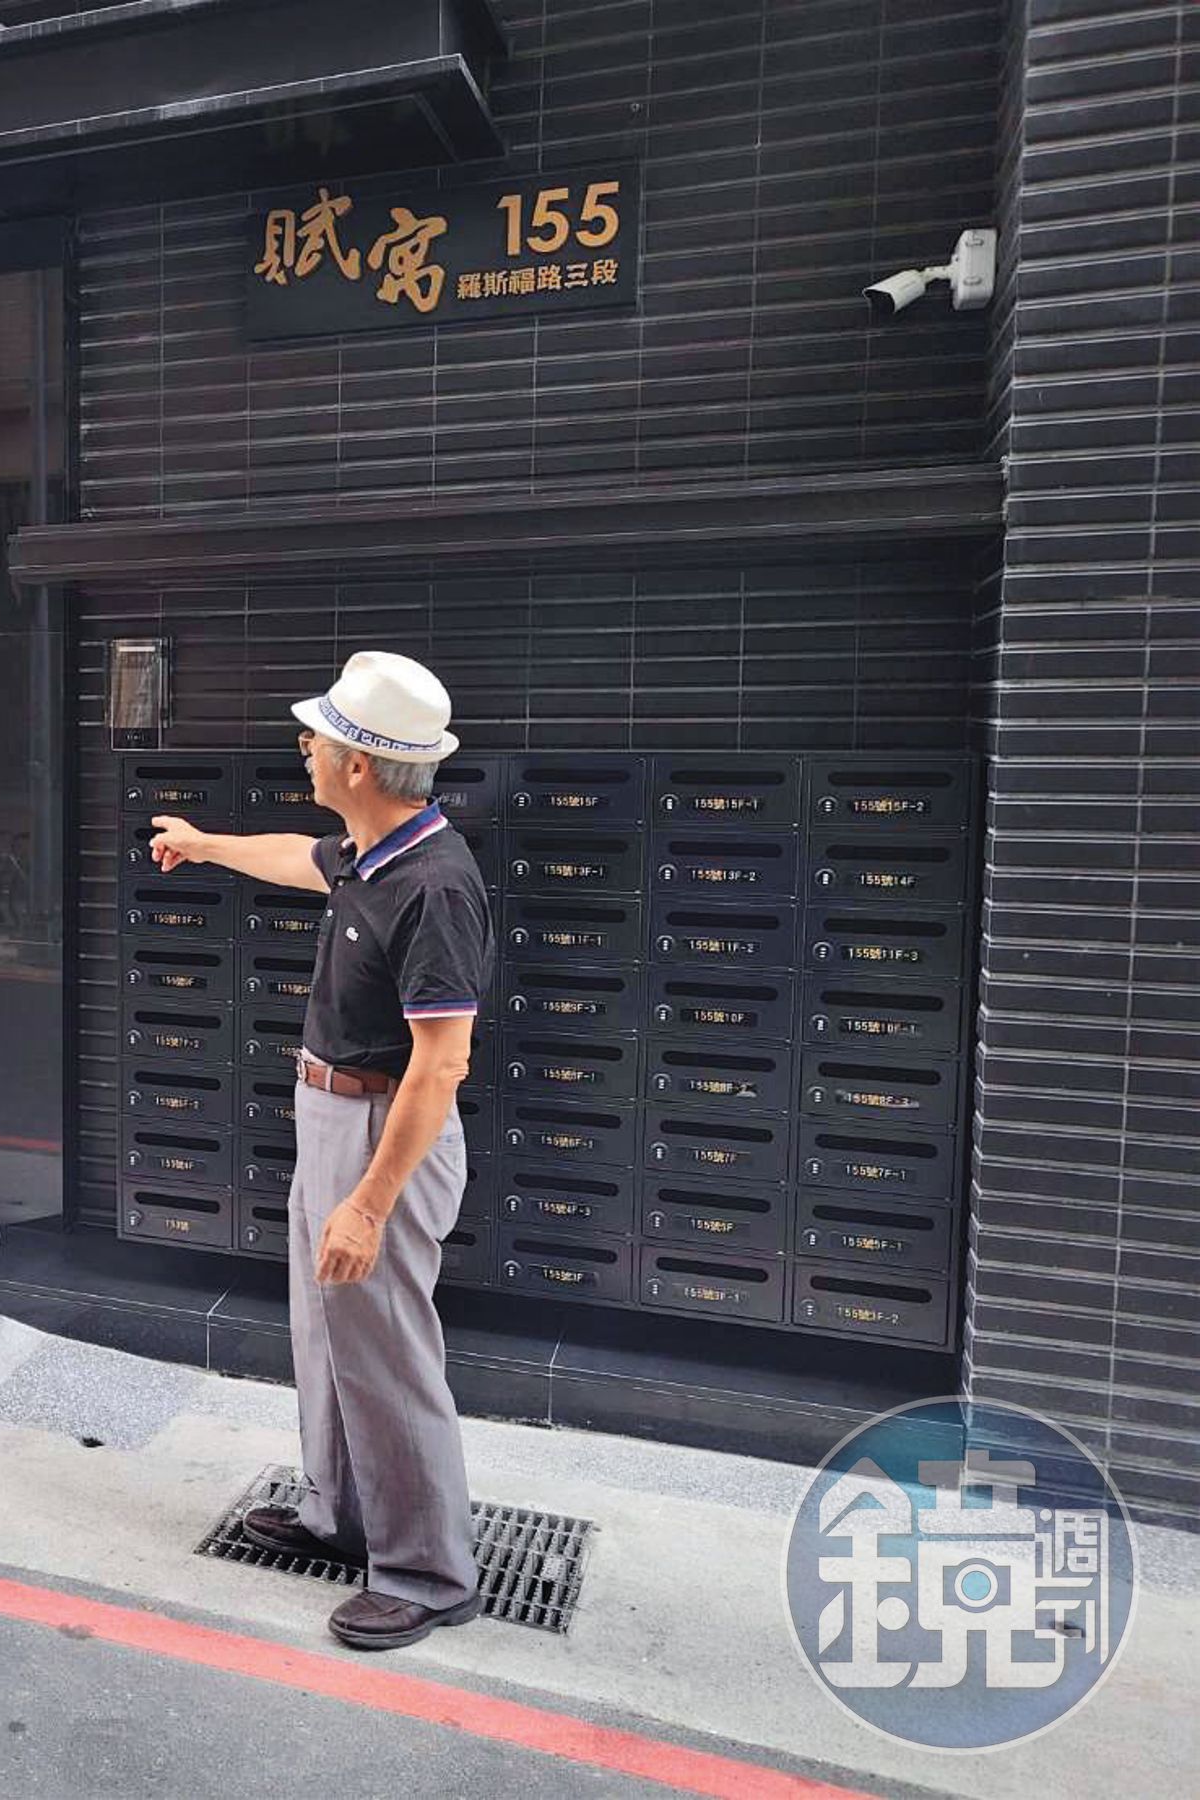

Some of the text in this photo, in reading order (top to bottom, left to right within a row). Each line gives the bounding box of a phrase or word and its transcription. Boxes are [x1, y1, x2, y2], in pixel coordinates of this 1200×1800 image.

[496, 181, 619, 256] 155
[456, 260, 619, 299] 羅斯福路三段
[695, 798, 758, 810] 155號15F-1
[854, 801, 924, 812] 155號15F-2
[692, 870, 755, 882] 155號13F-2
[861, 874, 914, 887] 155號14F
[849, 948, 918, 961] 155號11F-3
[694, 1011, 744, 1023] 155號10F
[846, 1165, 906, 1179] 155號7F-1
